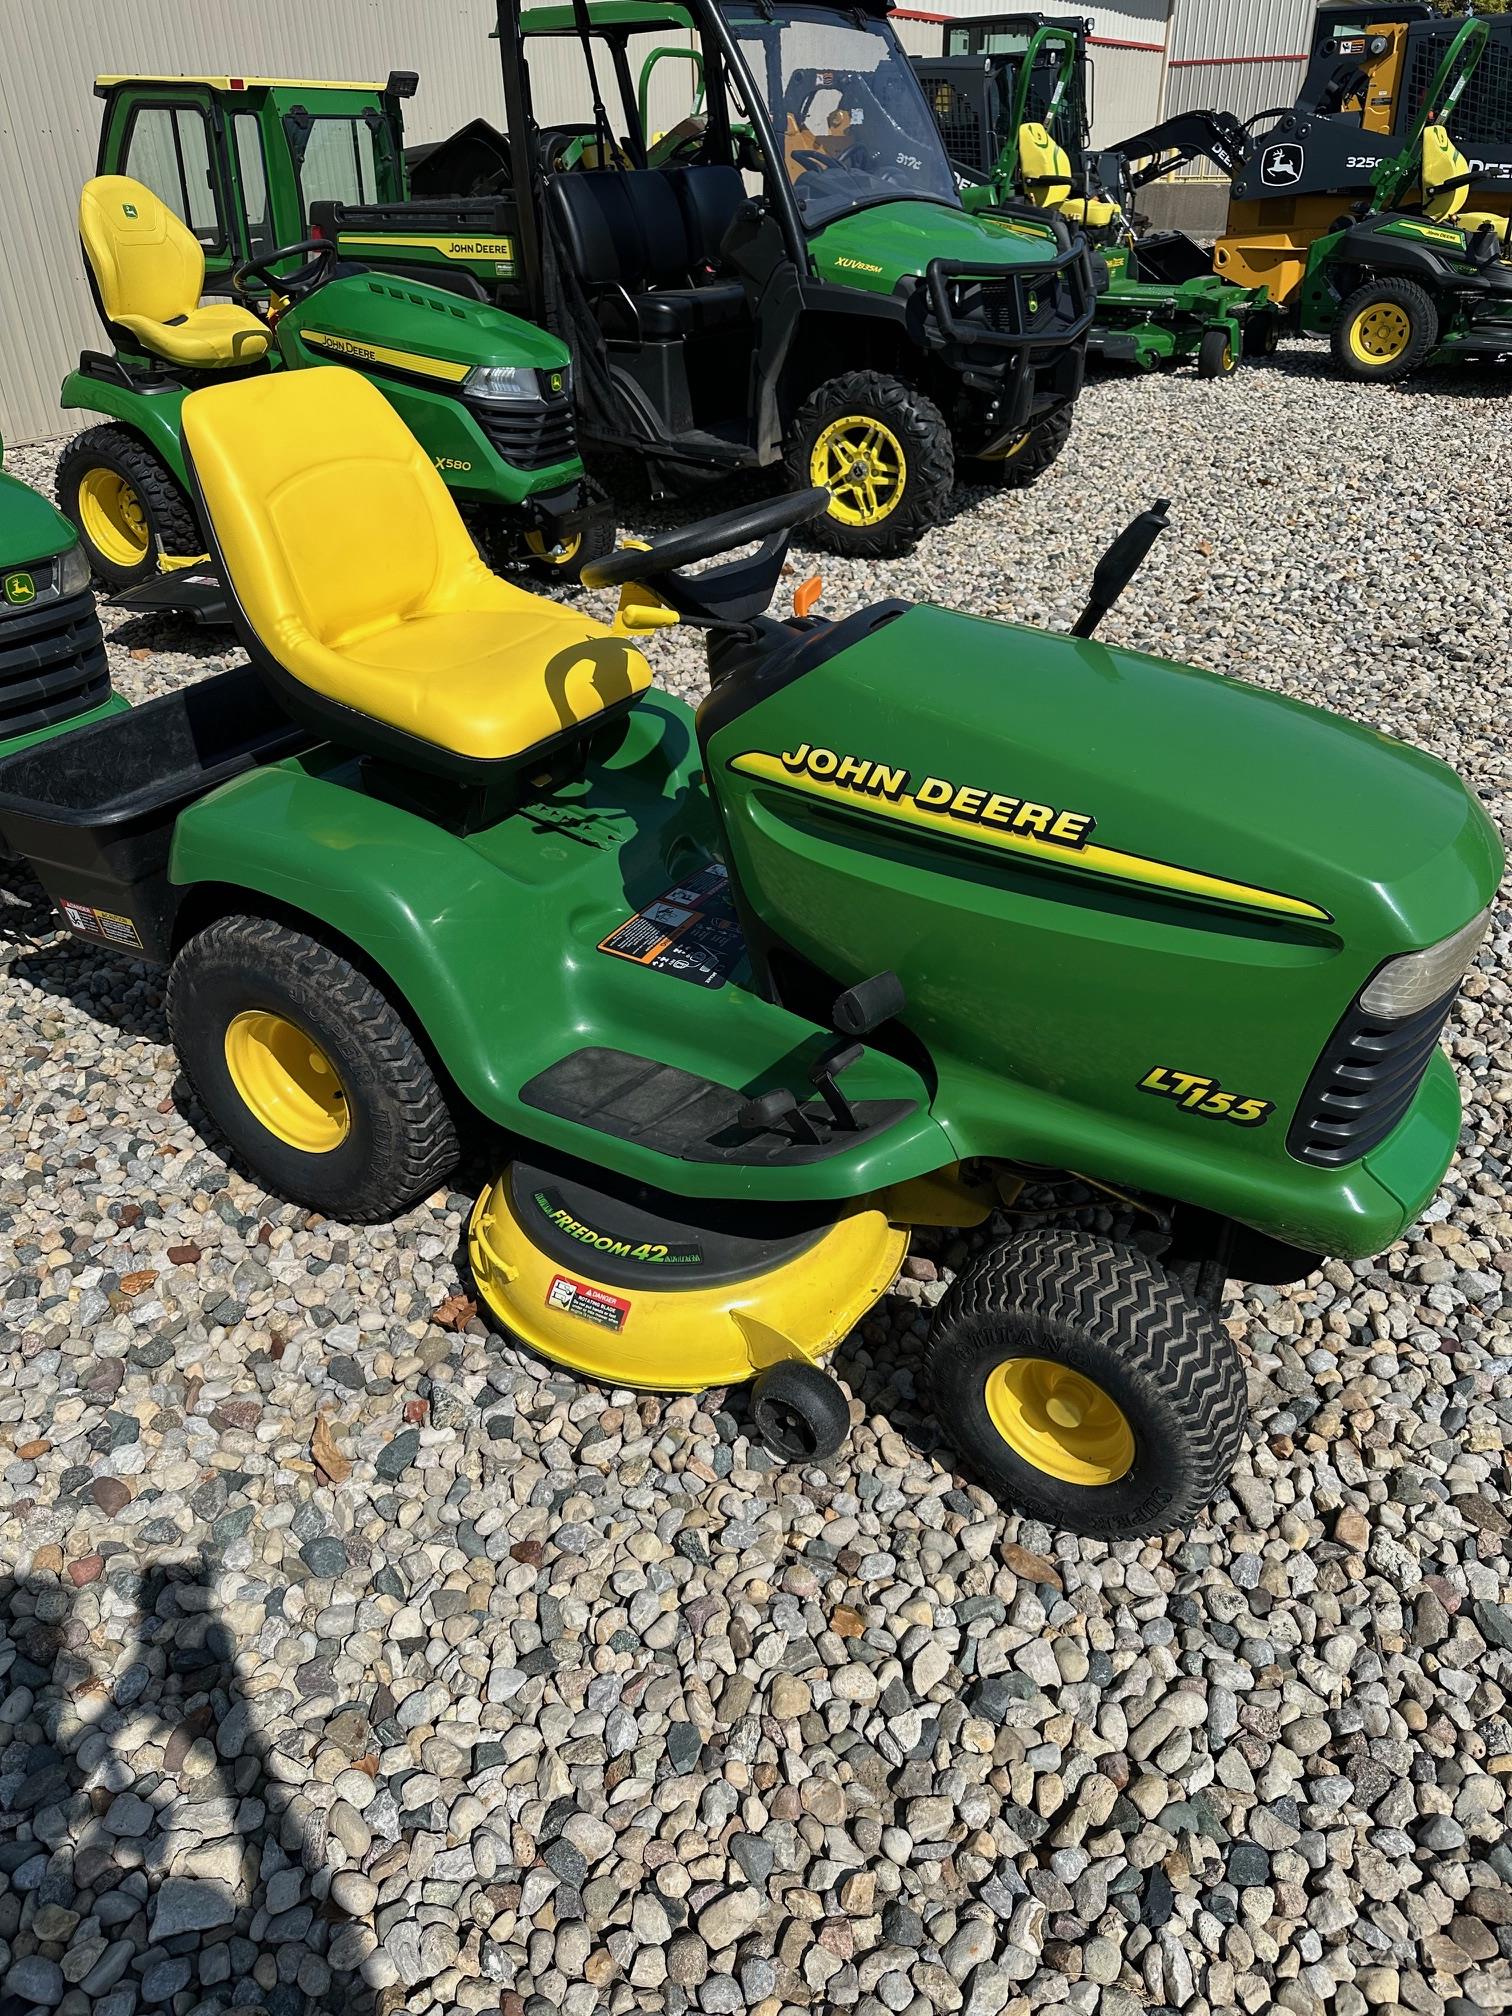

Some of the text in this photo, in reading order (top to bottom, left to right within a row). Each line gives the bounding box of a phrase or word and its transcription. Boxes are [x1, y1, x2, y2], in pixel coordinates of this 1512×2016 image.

[449, 242, 508, 254] JOHN DEERE
[321, 335, 376, 360] JOHN DEERE
[435, 456, 472, 471] X580
[781, 743, 1096, 848] JOHN DEERE
[1138, 1066, 1272, 1123] LT155
[550, 1209, 669, 1263] FREEDOM 42
[592, 1290, 617, 1305] DANGER
